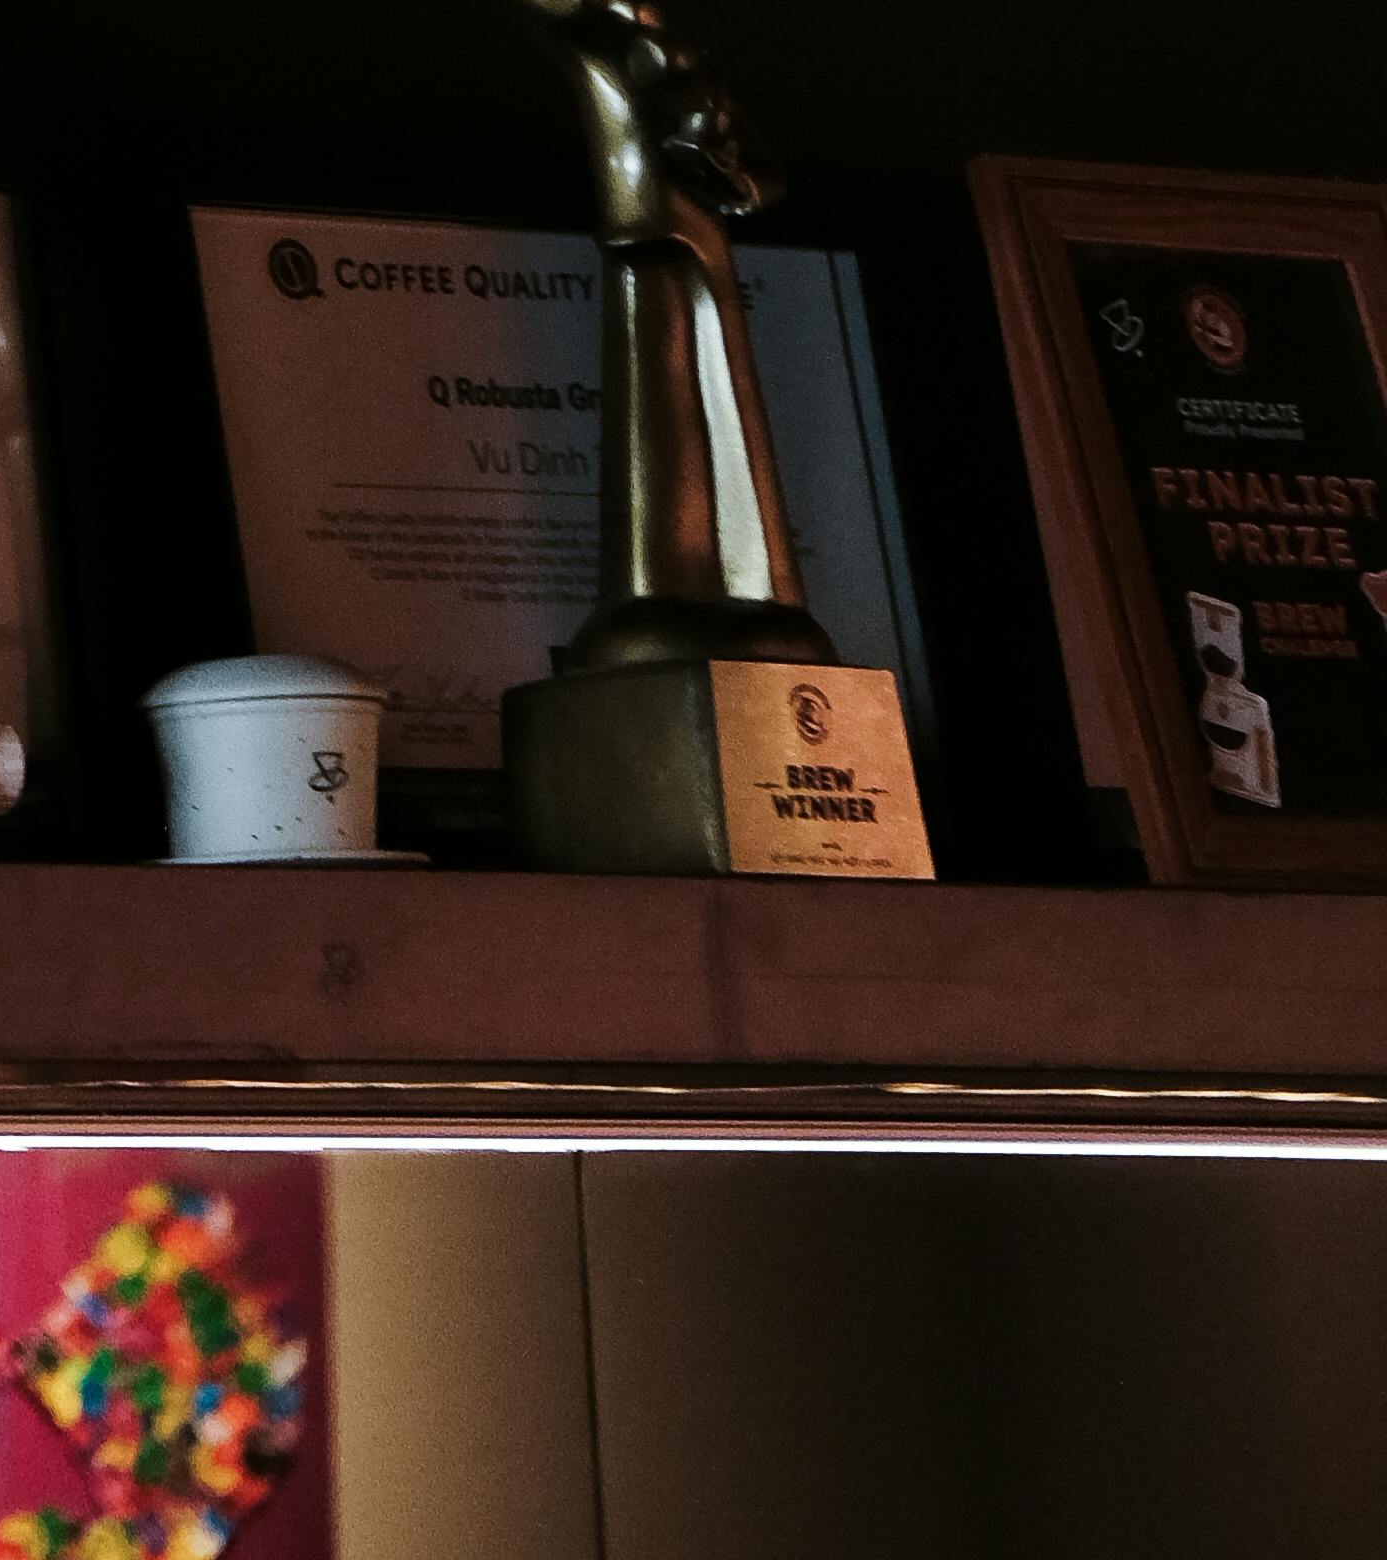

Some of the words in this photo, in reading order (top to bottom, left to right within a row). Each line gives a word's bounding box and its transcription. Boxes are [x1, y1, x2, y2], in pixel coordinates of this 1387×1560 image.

[334, 257, 453, 296] COFFEE
[464, 264, 594, 303] QUALITY
[427, 375, 451, 409] Q
[454, 377, 562, 410] Robusta
[1175, 395, 1305, 425] CERTIFICATE
[1150, 464, 1380, 521] FINALIST
[1205, 519, 1360, 570] PRIZE
[784, 764, 856, 793] BREW
[770, 794, 879, 825] WINNER
